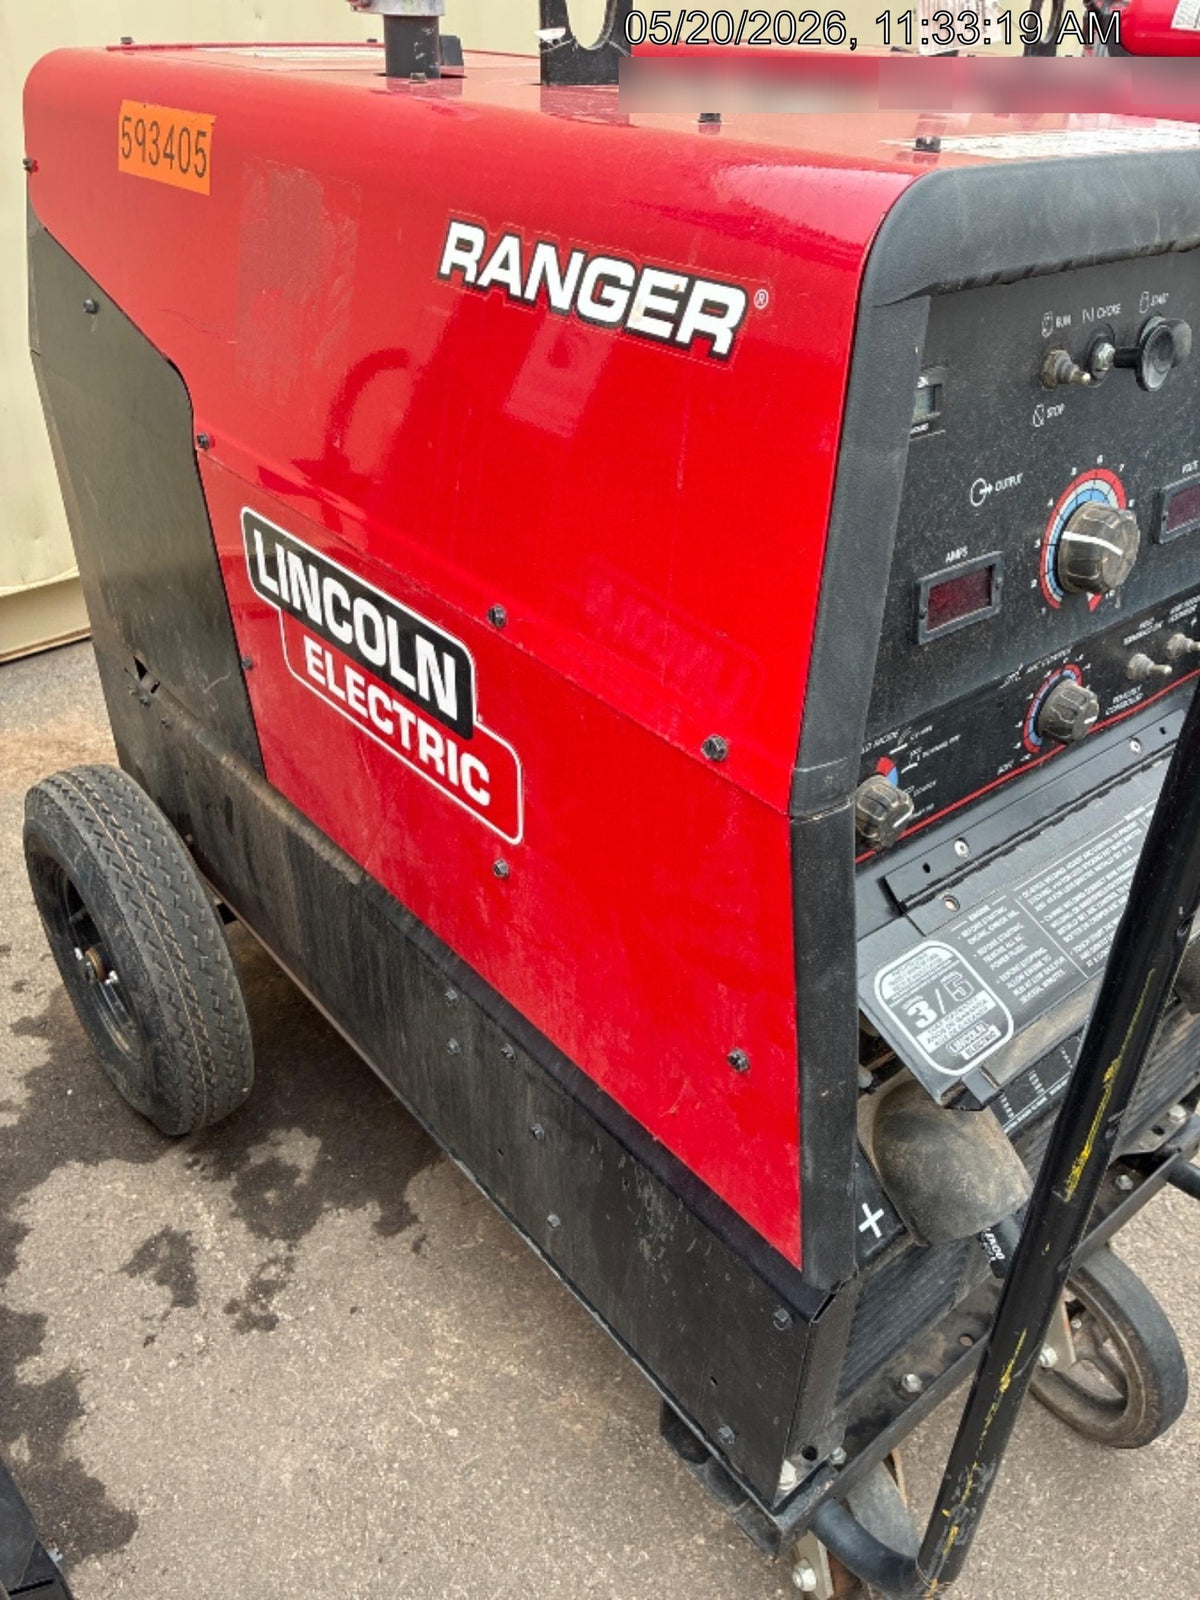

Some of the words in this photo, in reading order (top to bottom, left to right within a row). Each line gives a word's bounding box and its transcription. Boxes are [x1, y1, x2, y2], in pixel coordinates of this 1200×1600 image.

[120, 115, 207, 179] 593405
[438, 219, 748, 359] RANGER
[994, 472, 1023, 492] OUTPUT
[253, 528, 459, 721] LINCOLN
[303, 634, 491, 807] ELECTRIC
